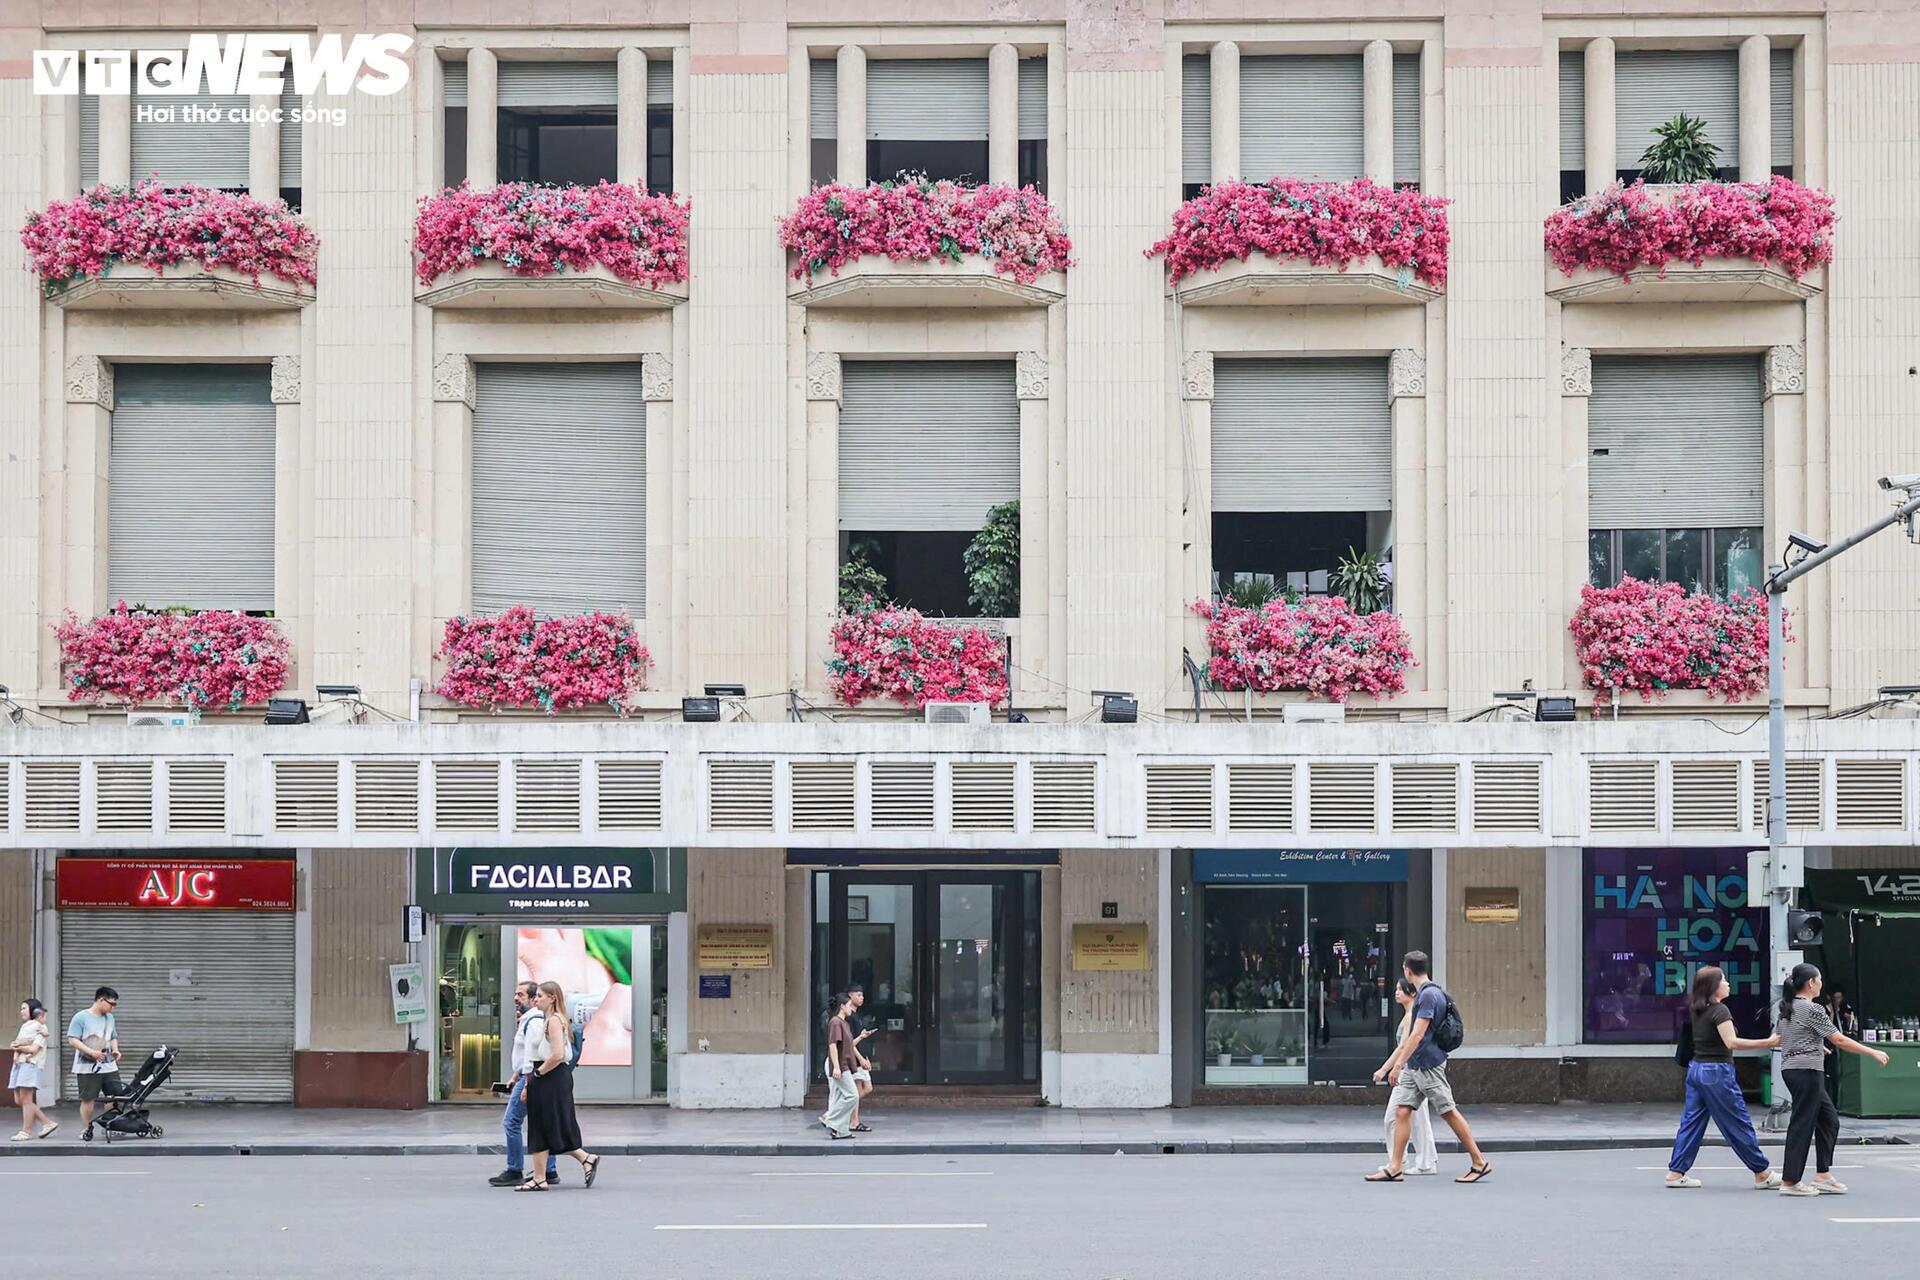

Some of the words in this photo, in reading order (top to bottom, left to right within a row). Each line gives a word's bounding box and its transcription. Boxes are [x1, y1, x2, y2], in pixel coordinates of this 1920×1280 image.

[1280, 850, 1314, 861] Exhibition
[1315, 850, 1339, 861] Center
[1340, 851, 1346, 861] &
[1364, 850, 1391, 862] Gallery
[471, 864, 633, 889] FACIALBAR
[139, 870, 214, 906] AJC
[559, 898, 576, 908] SÓC
[577, 900, 590, 908] DA
[1104, 905, 1116, 915] 91
